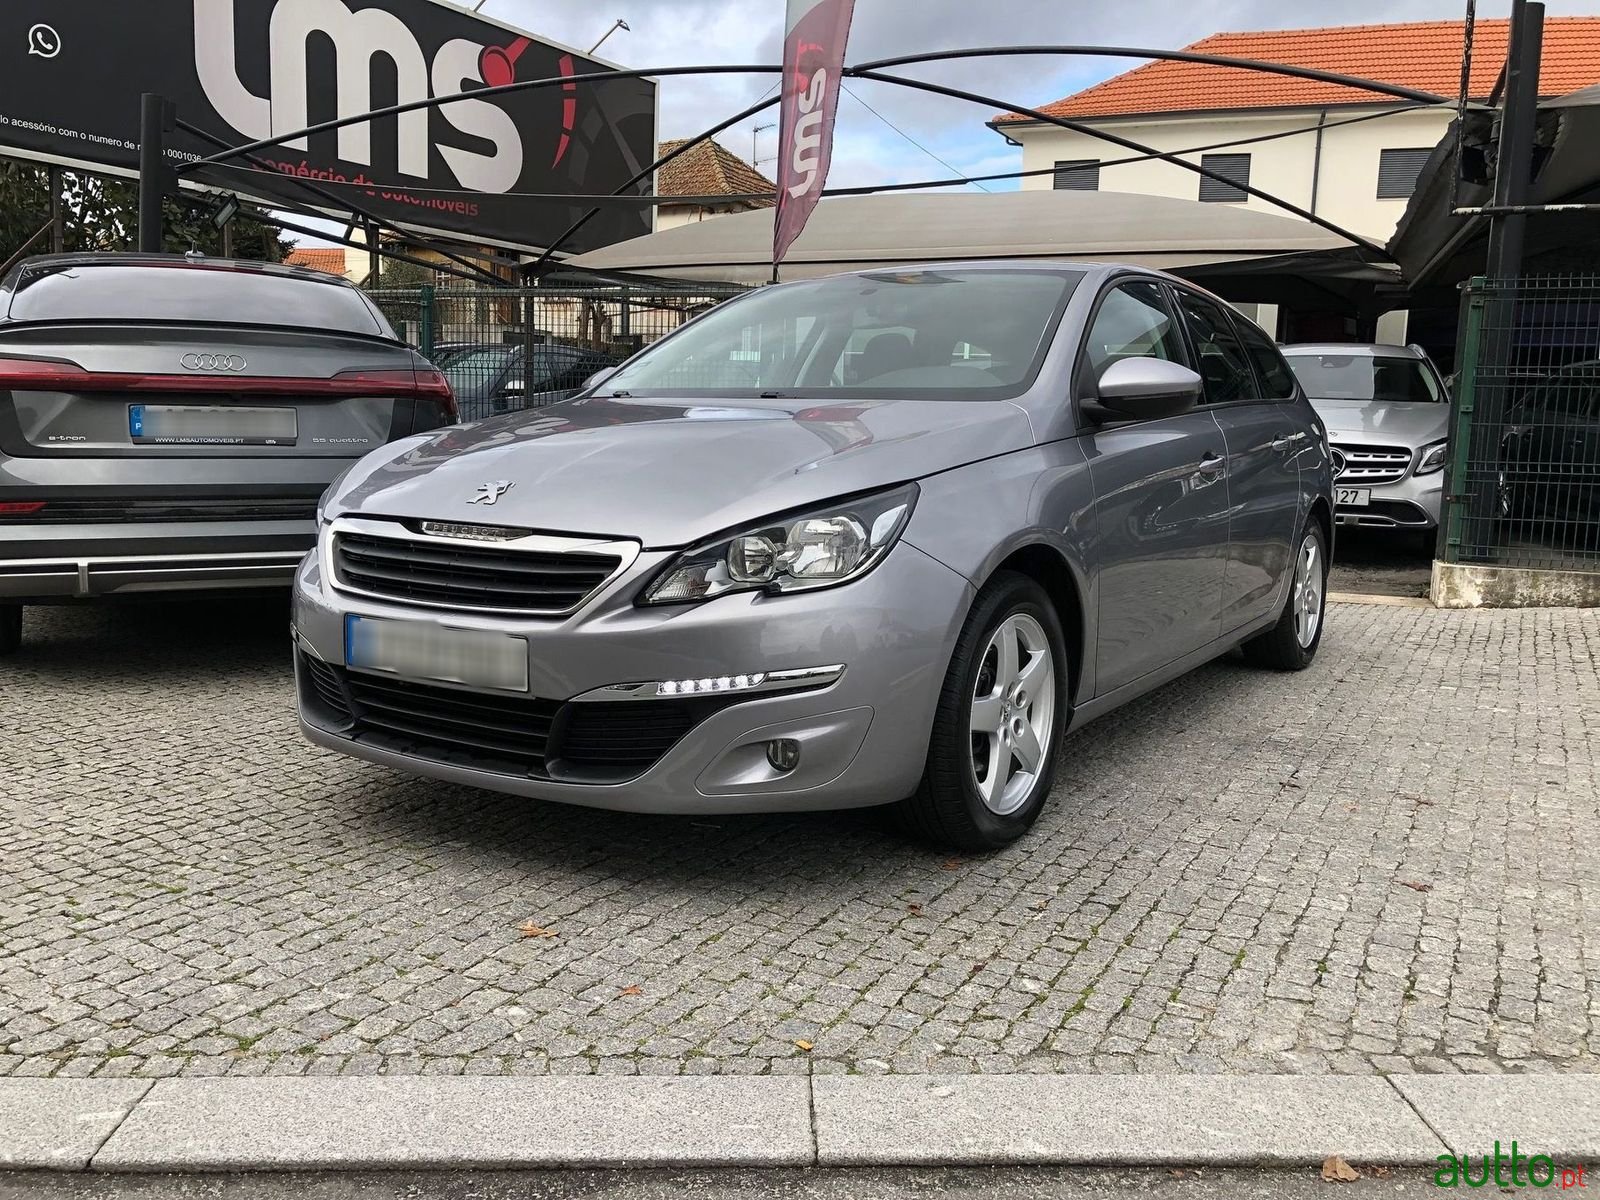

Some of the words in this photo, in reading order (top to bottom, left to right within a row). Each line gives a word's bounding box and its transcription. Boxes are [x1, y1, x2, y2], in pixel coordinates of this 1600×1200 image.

[11, 118, 57, 134] acessório
[58, 128, 78, 138] com
[88, 133, 122, 146] numero
[124, 139, 135, 150] de
